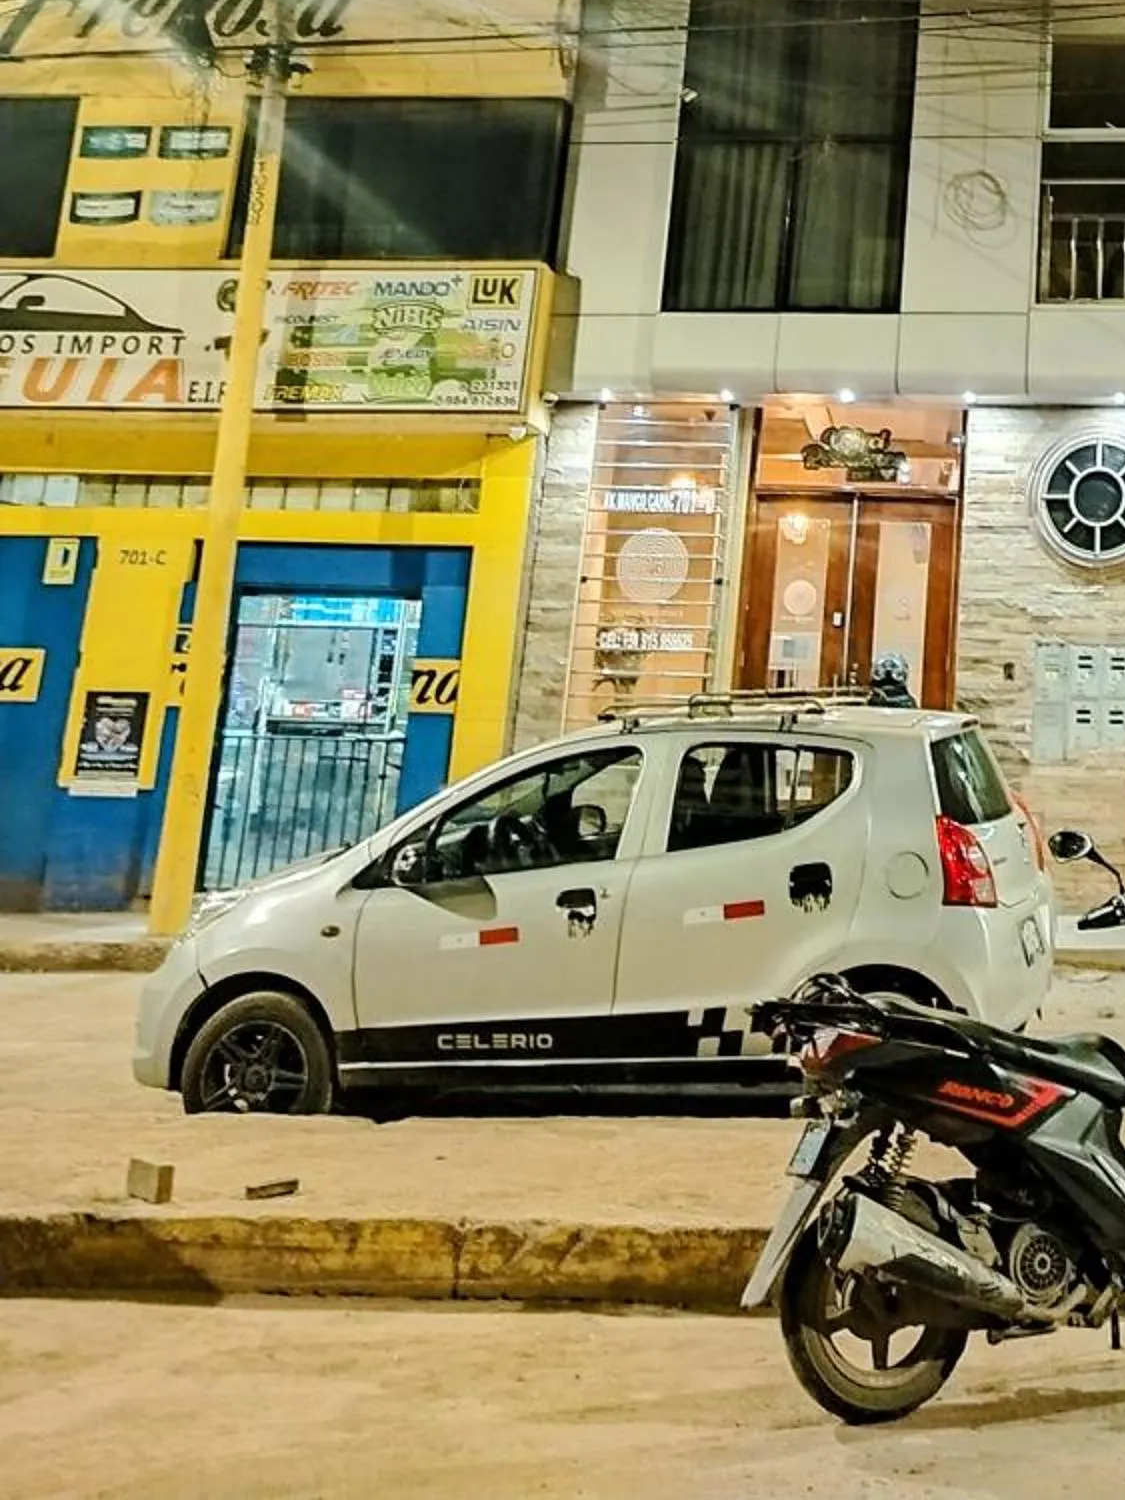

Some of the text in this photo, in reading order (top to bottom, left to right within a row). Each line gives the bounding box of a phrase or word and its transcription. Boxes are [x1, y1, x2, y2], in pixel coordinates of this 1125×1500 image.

[374, 281, 451, 297] MANDO
[54, 335, 187, 355] IMPORT
[119, 549, 167, 565] 701-C
[437, 1033, 553, 1050] CELERIO
